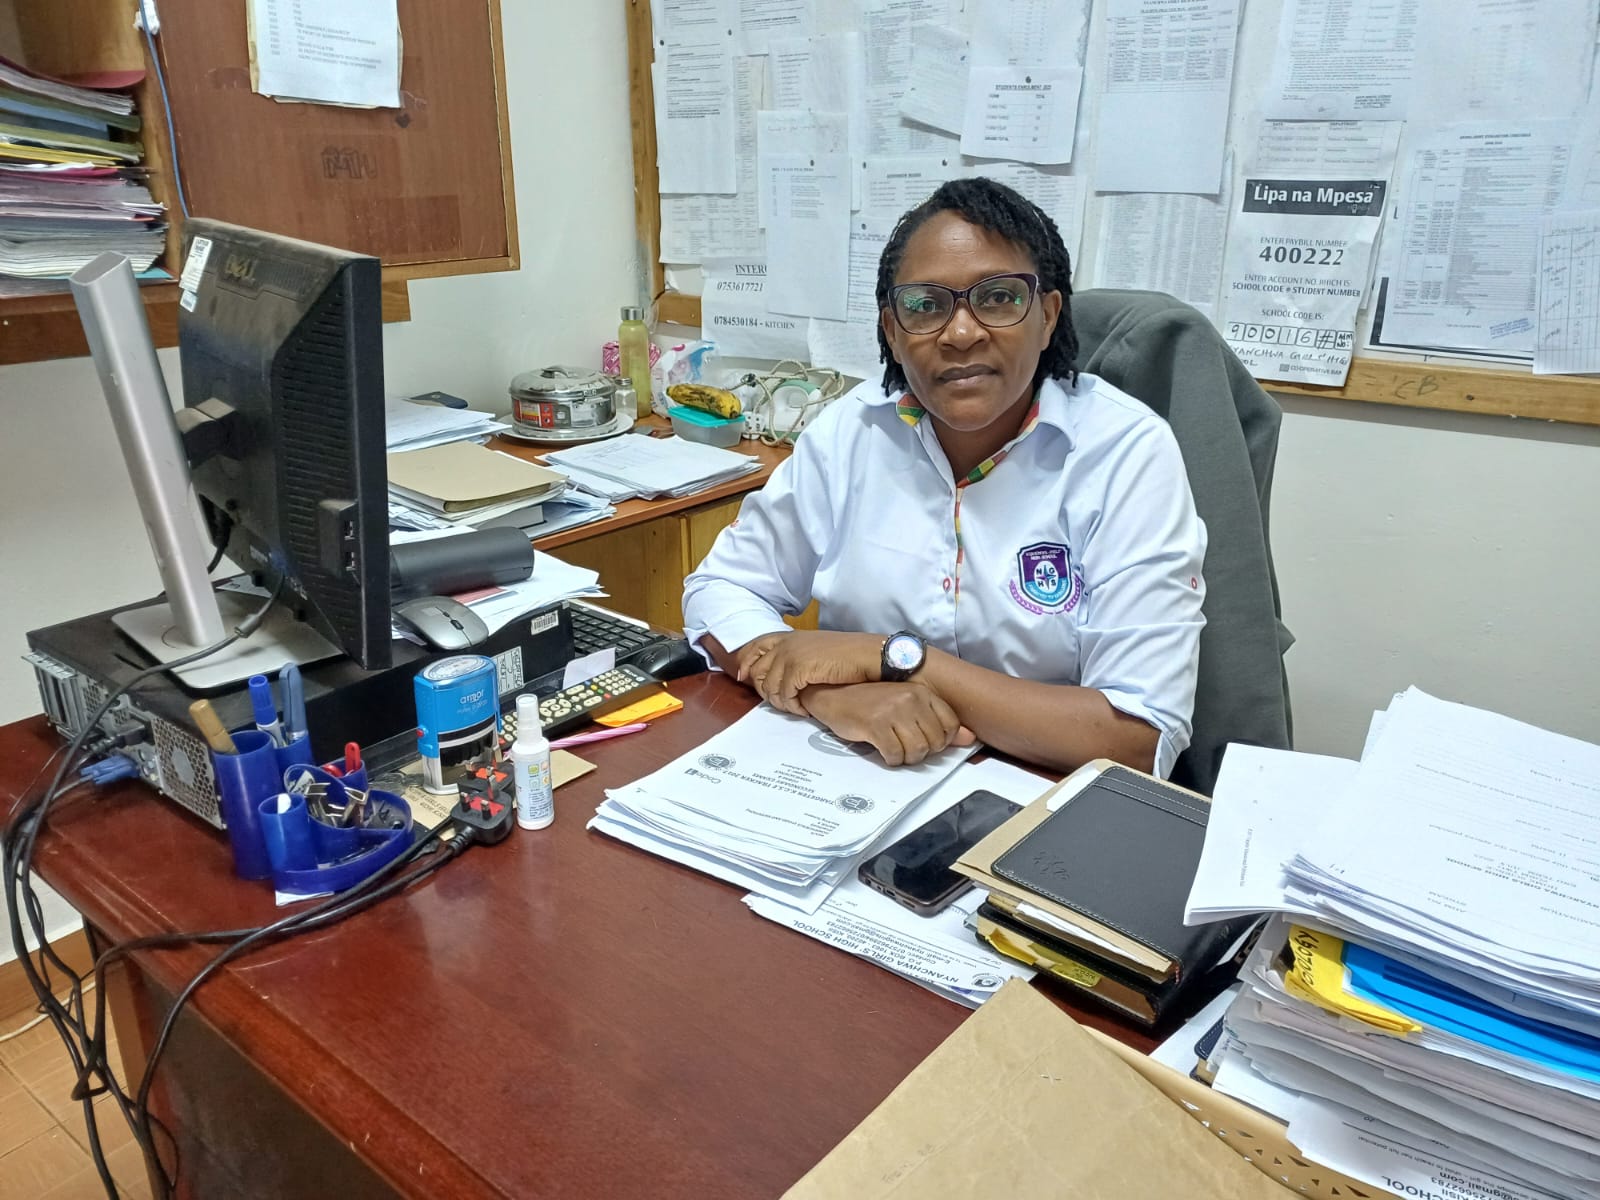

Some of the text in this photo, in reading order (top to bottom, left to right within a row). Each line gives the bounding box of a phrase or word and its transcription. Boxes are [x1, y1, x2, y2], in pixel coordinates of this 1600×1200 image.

[1253, 183, 1374, 208] Lipa na Mpesa
[1258, 244, 1343, 266] 400222
[1244, 273, 1266, 282] ENTER
[1268, 275, 1303, 284] ACCOUNT
[1232, 282, 1261, 291] SCHOOL
[1262, 284, 1282, 292] CODE
[1292, 286, 1324, 295] STUDENT
[1326, 288, 1360, 297] NUMBER
[713, 315, 758, 327] 0784530184
[1261, 309, 1291, 317] SCHOOL
[1293, 311, 1313, 319] CODE
[790, 919, 958, 984] NYANCHWA GIRLS' HIGH SCHOOL
[1381, 1176, 1444, 1200] CHOOL
